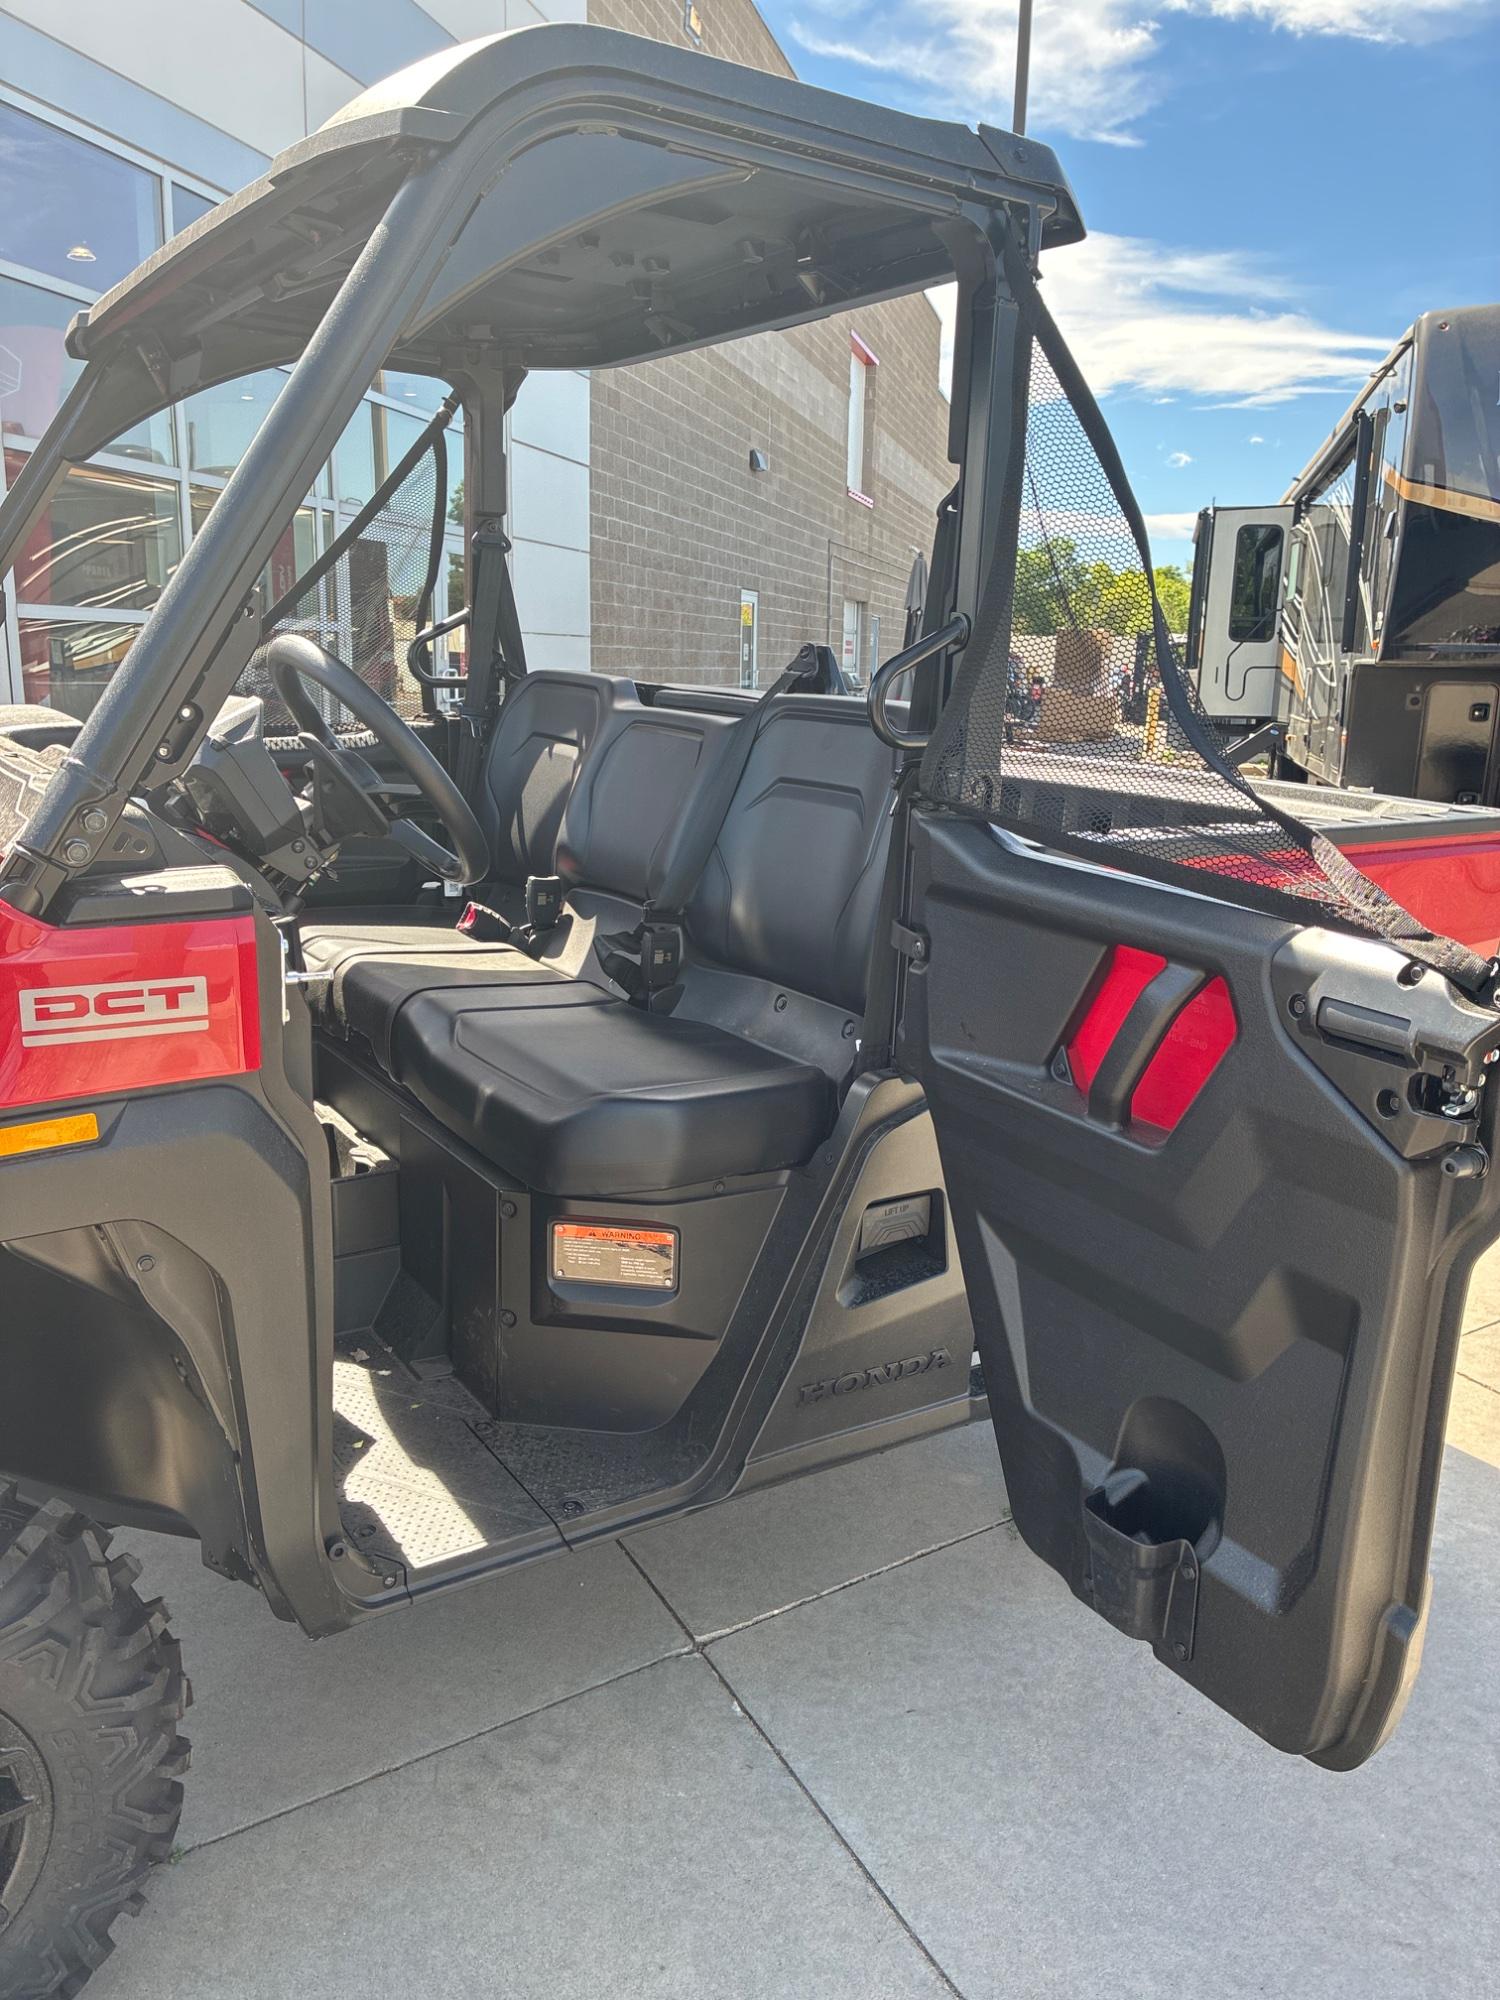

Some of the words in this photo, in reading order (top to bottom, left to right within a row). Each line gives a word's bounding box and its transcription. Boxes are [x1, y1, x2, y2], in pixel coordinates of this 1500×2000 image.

[34, 984, 195, 1022] DCT
[884, 1206, 898, 1217] LIFT
[601, 1230, 642, 1241] WARNING
[800, 1347, 953, 1403] HONDA
